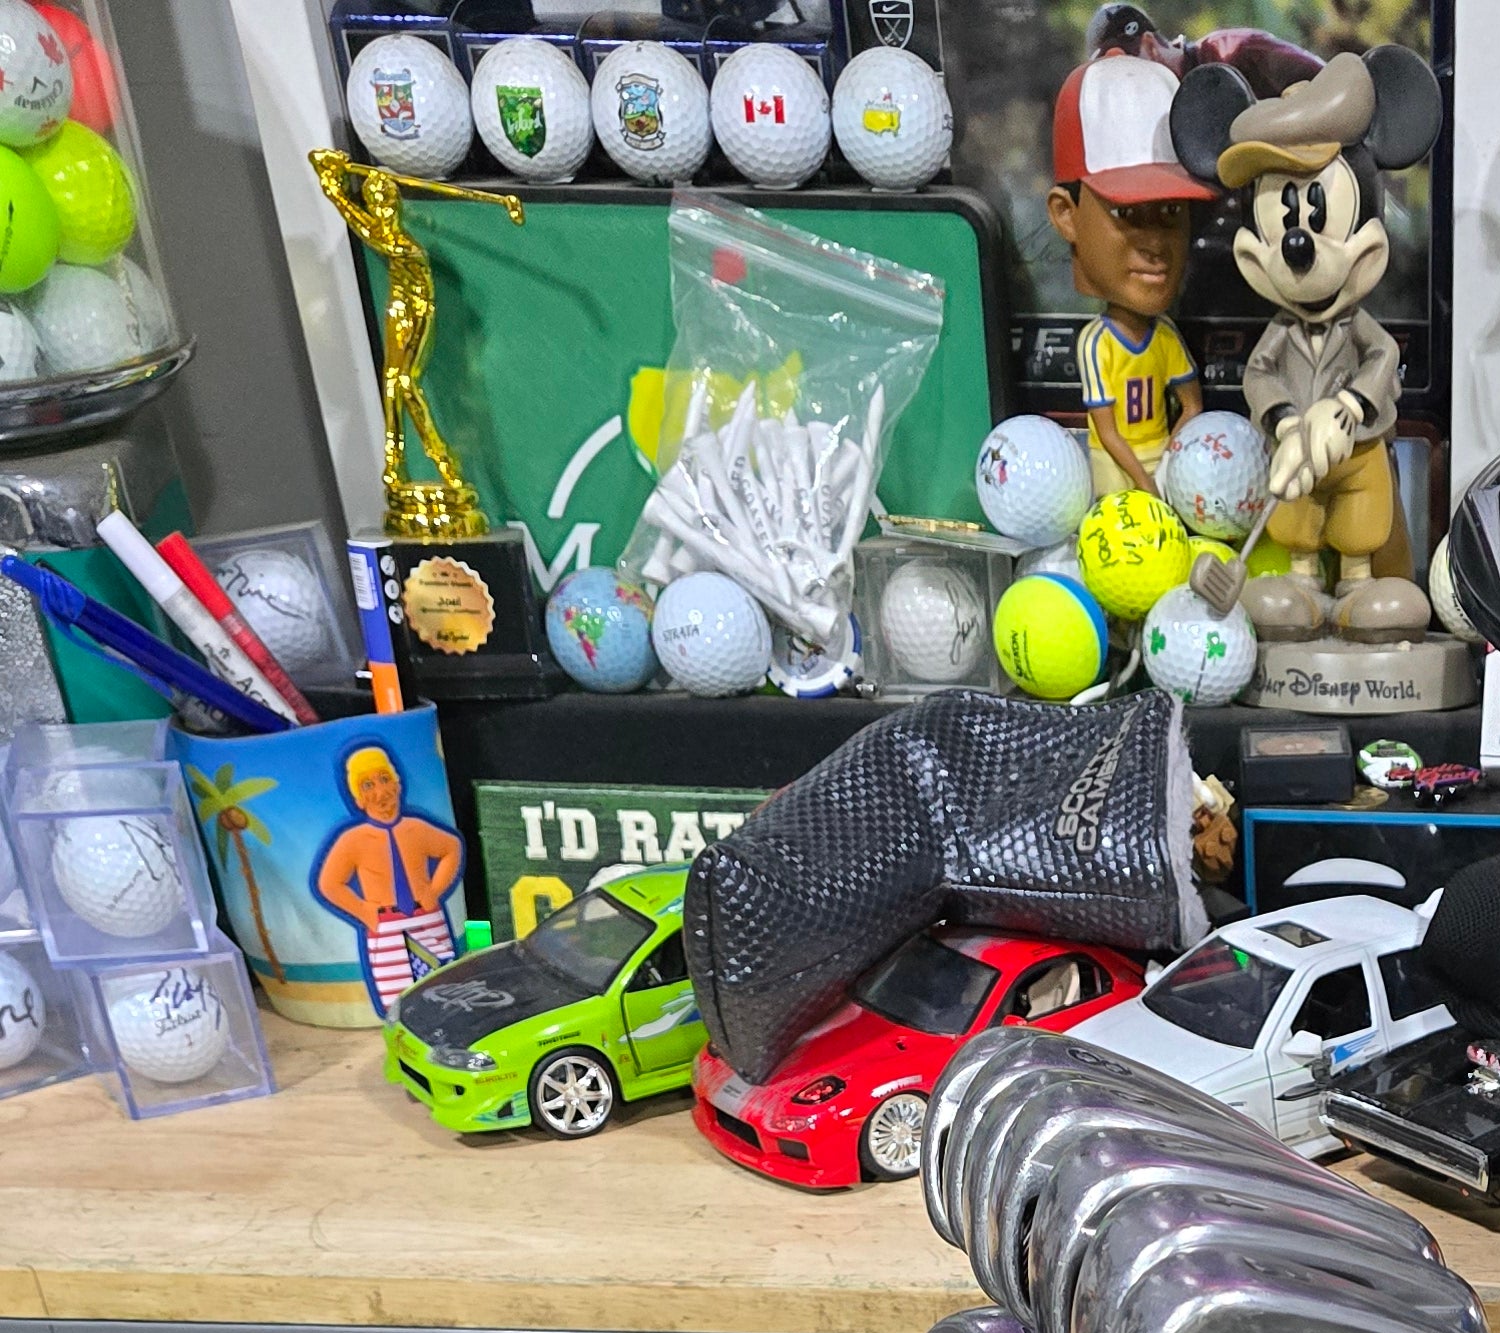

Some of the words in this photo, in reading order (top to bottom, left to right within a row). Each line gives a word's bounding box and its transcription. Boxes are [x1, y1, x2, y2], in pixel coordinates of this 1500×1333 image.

[662, 624, 700, 643] STRATA
[1365, 679, 1415, 700] World
[520, 801, 599, 861] I'D
[616, 807, 750, 864] RAT
